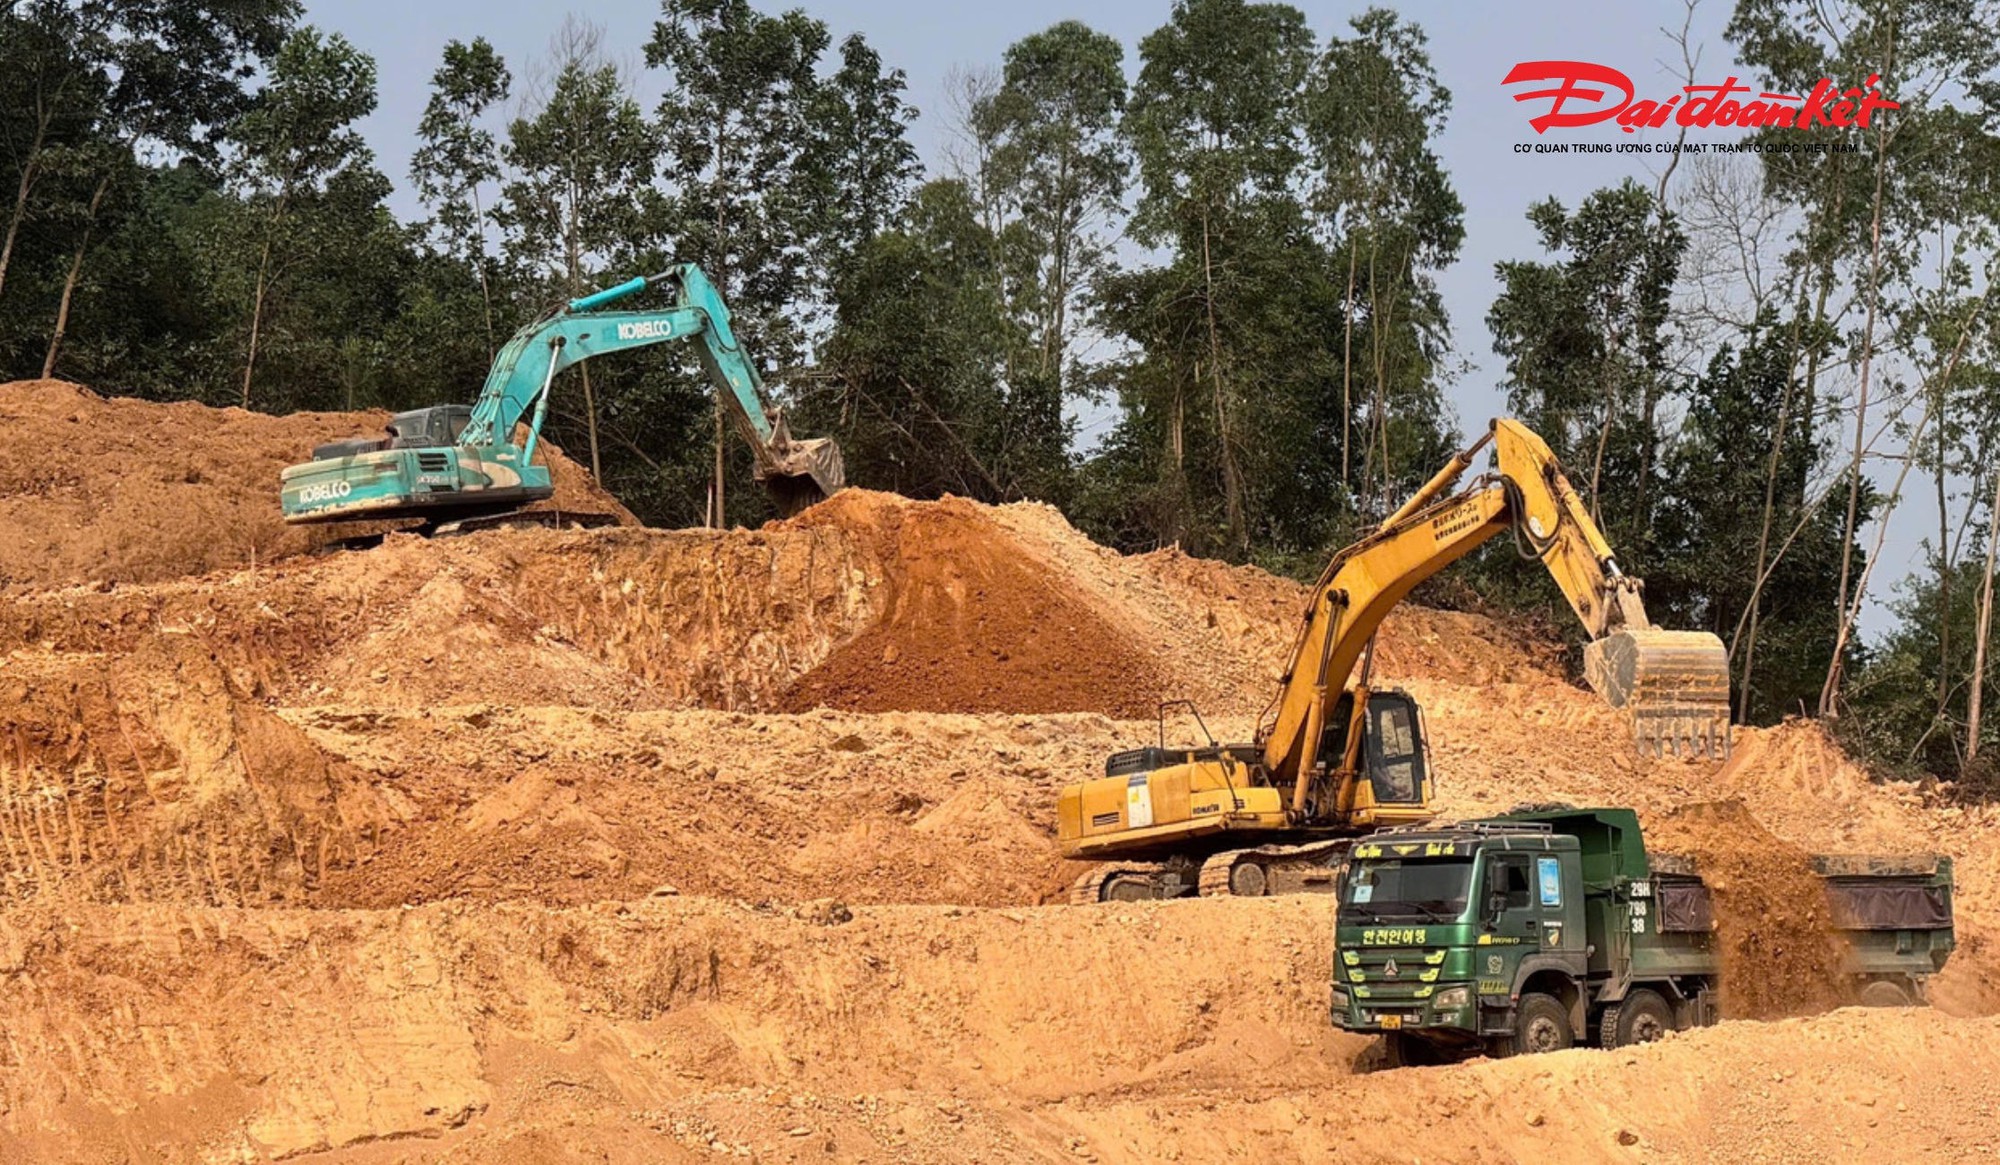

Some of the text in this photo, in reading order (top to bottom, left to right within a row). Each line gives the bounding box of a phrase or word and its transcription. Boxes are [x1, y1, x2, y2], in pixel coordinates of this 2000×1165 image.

[617, 319, 672, 340] KOBELCO
[300, 481, 351, 503] KOBELCO
[1630, 882, 1650, 897] 29H
[1631, 917, 1645, 933] 38
